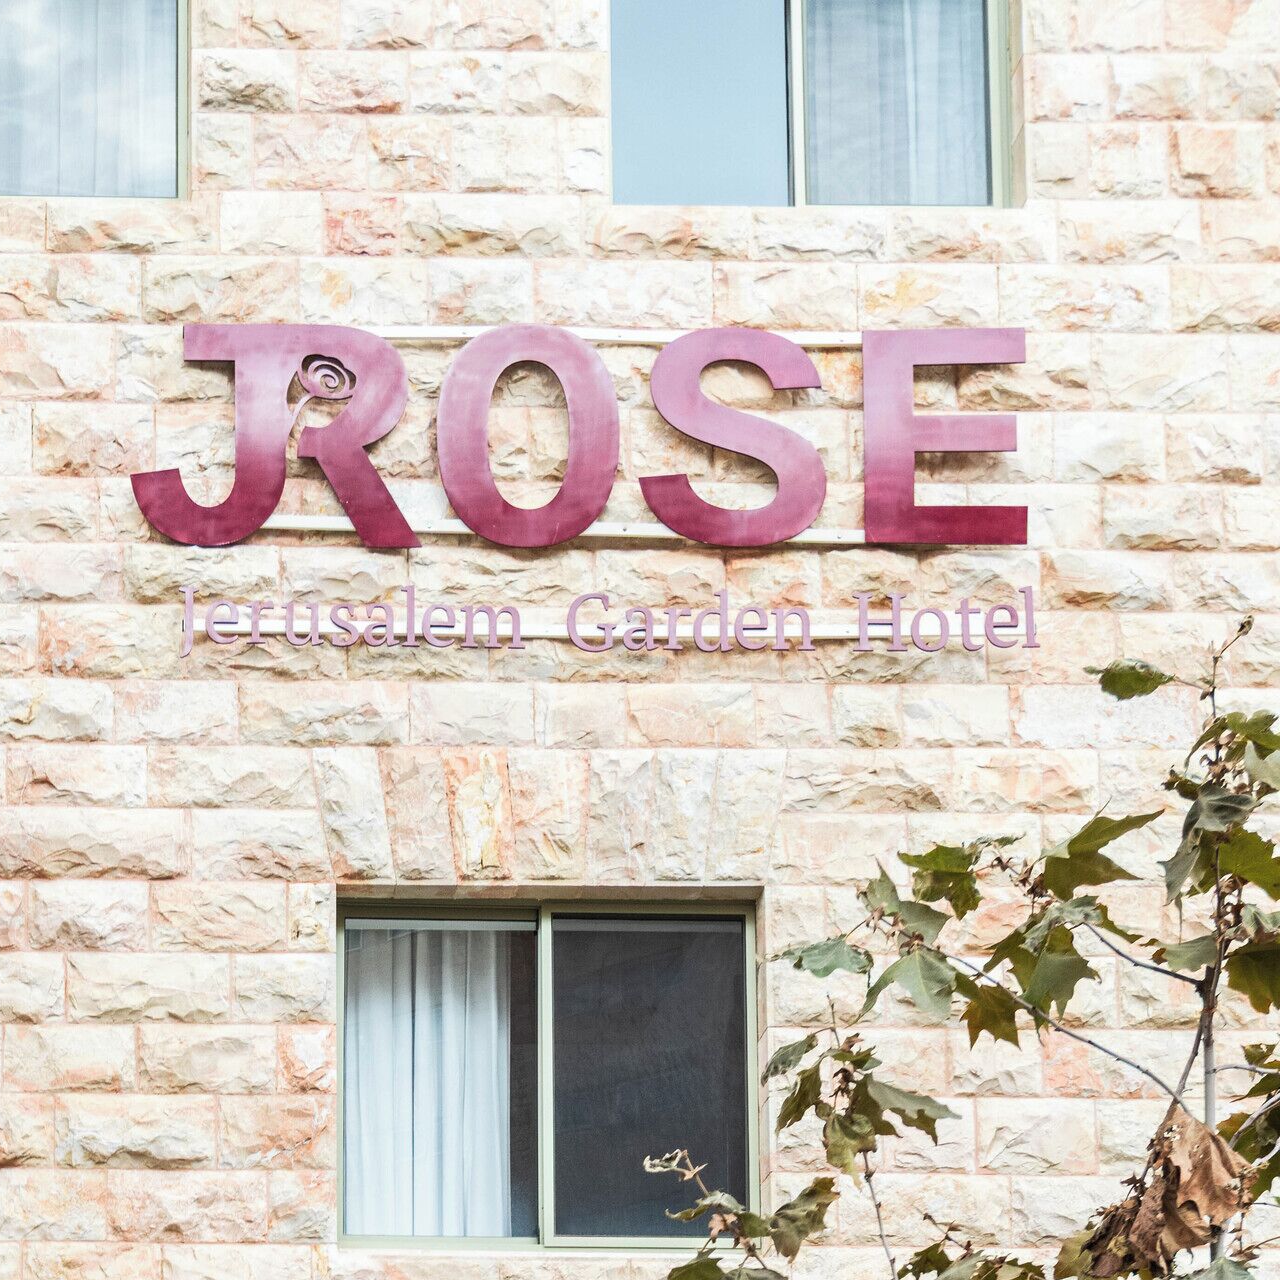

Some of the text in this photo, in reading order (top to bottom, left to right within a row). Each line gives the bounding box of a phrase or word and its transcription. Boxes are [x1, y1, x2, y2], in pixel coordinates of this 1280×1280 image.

[131, 323, 1029, 548] JROSE
[180, 585, 1041, 659] Jerusalem Garden Hotel
